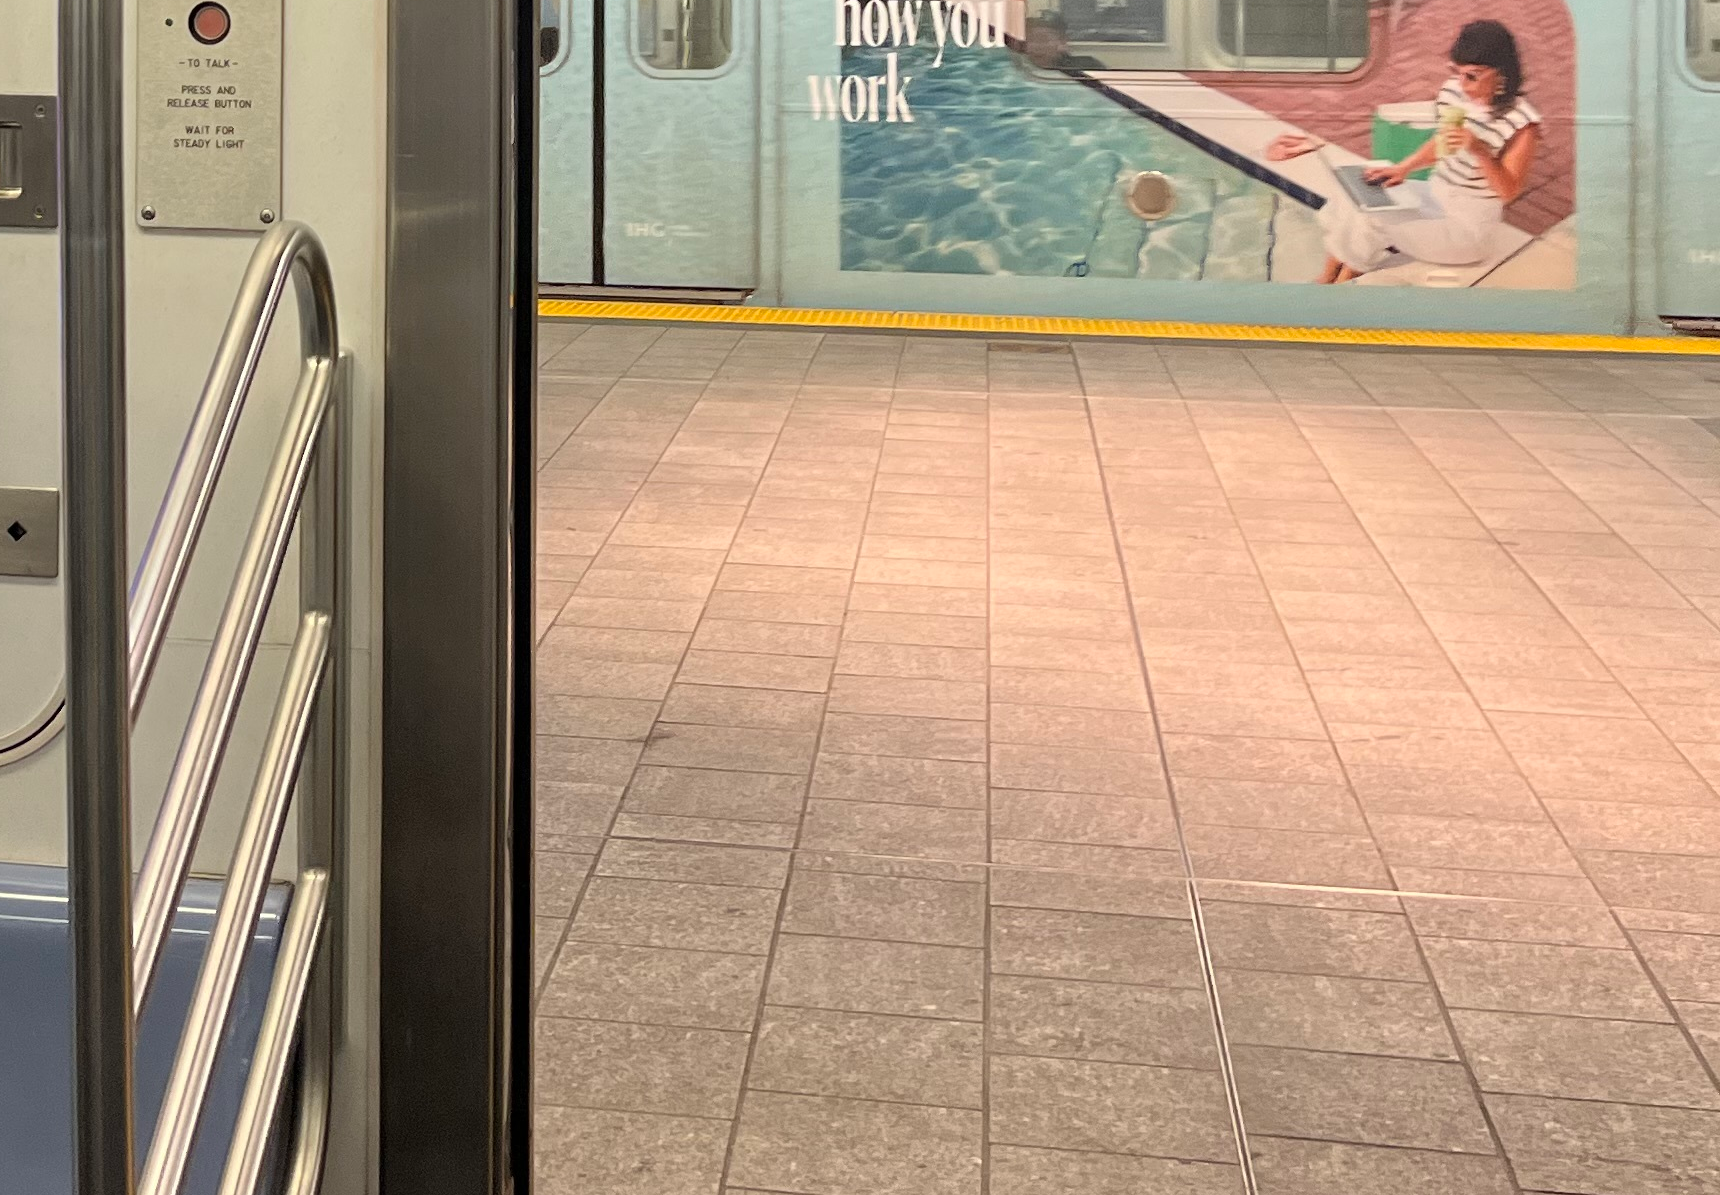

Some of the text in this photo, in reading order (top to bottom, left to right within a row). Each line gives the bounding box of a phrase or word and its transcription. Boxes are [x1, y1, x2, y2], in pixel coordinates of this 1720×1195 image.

[182, 85, 236, 95] PRESS AND
[808, 52, 917, 123] work
[167, 99, 252, 108] RELEASE BUTTON
[185, 126, 235, 135] WAIT FOR
[173, 139, 245, 149] STEADY LIGHT
